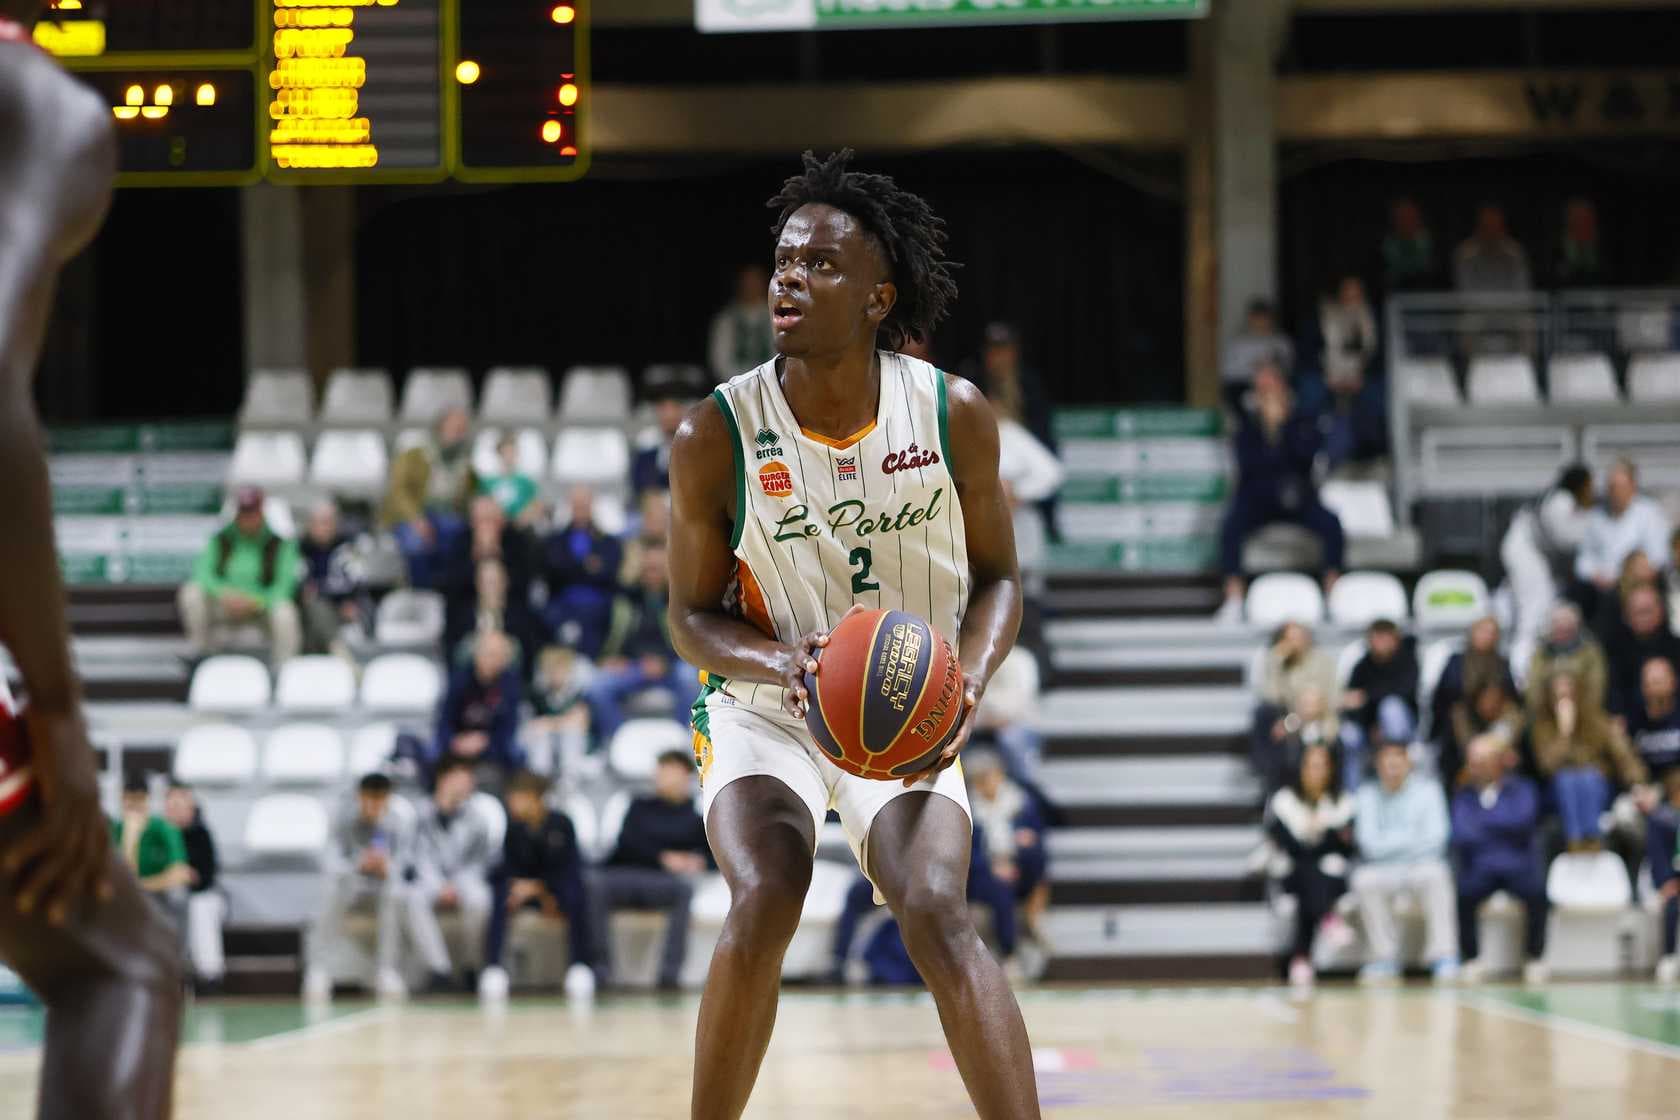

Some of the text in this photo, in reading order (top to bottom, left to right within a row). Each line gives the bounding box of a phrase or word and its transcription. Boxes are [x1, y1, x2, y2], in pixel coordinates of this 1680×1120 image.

[759, 471, 790, 482] BURGER
[762, 479, 792, 491] KING
[773, 488, 943, 542] Le Portel
[849, 547, 880, 594] 2
[889, 622, 924, 712] LEGACY
